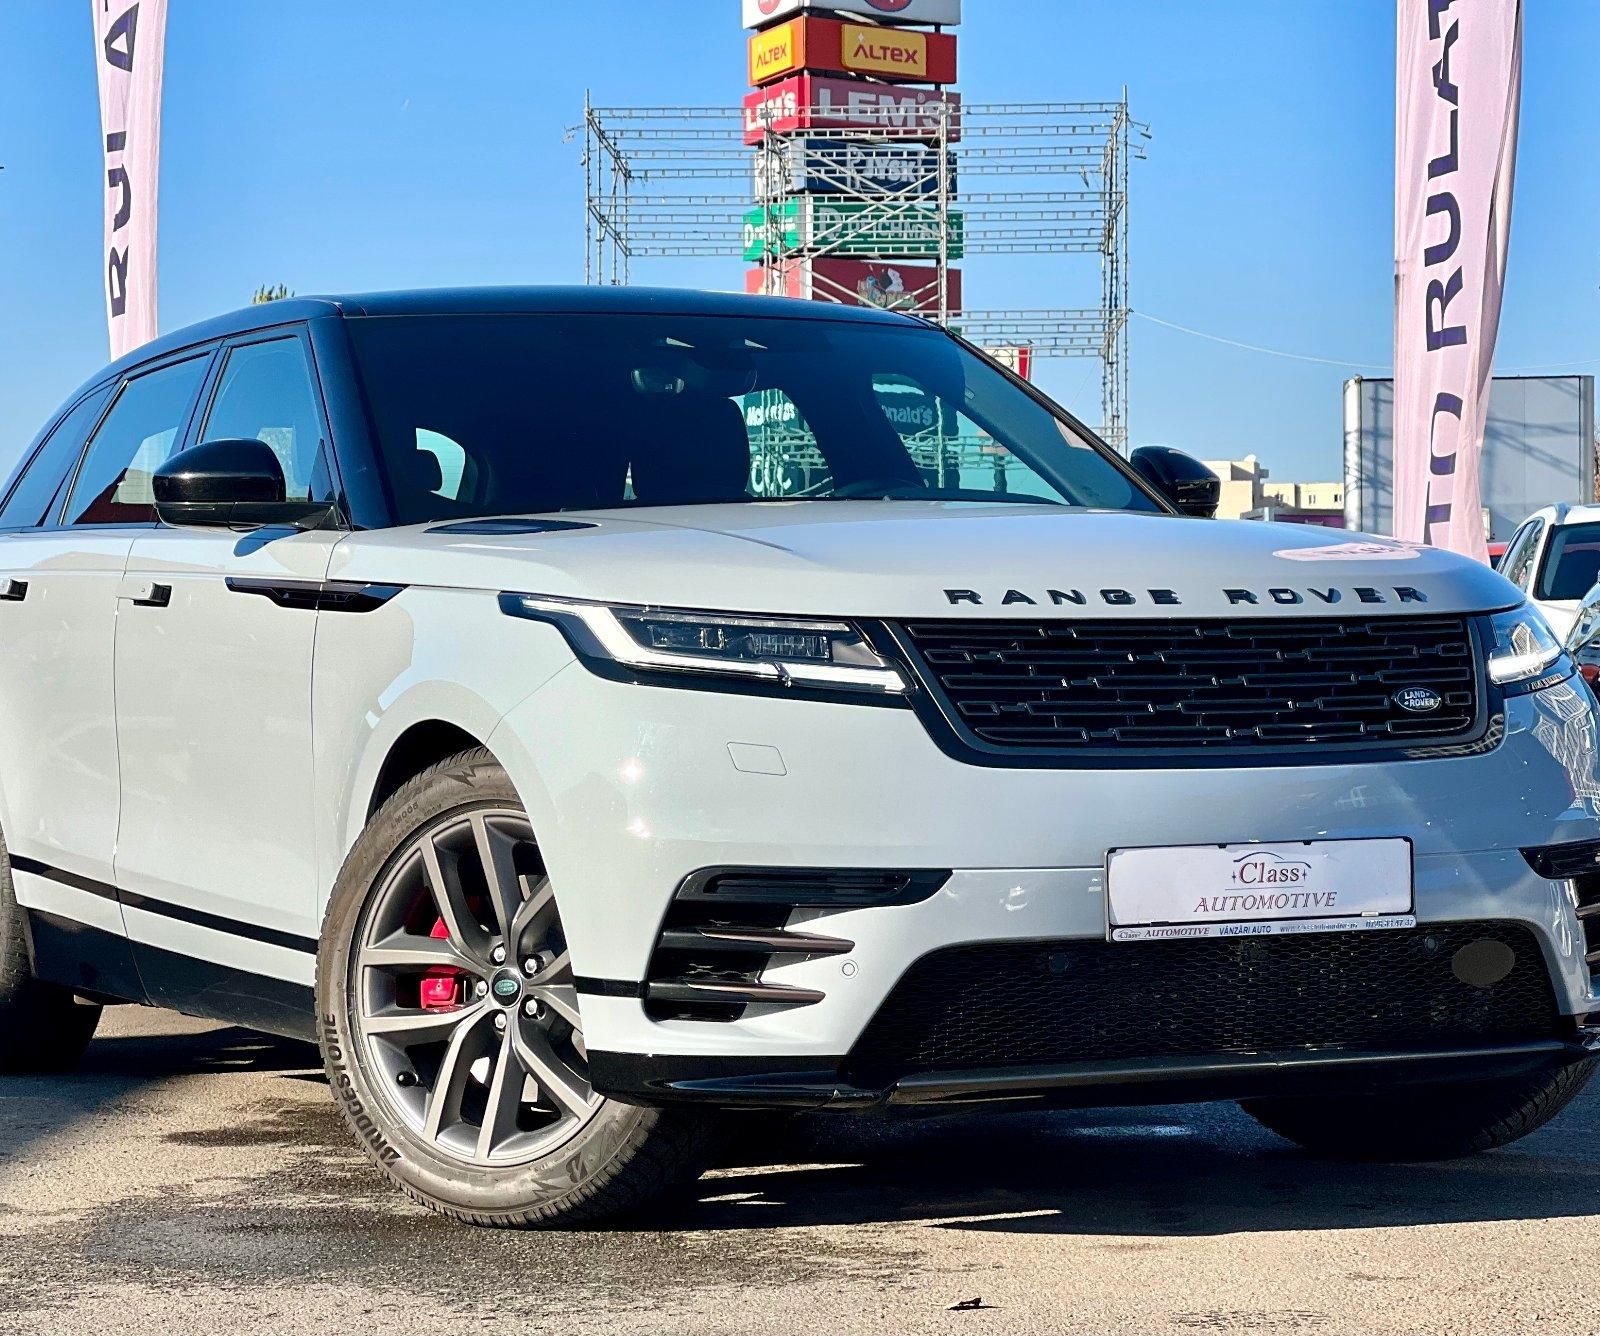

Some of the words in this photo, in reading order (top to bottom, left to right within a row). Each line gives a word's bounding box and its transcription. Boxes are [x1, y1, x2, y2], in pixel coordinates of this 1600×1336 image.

[943, 589, 1183, 605] RANGE
[1222, 587, 1428, 604] ROVER
[1404, 691, 1425, 699] LAND
[1409, 698, 1435, 707] ROVER
[1239, 862, 1300, 884] Class
[1193, 891, 1338, 913] AUTOMOTIVE
[1144, 927, 1210, 938] AUTOMOTIVE
[1252, 925, 1271, 934] AUTO
